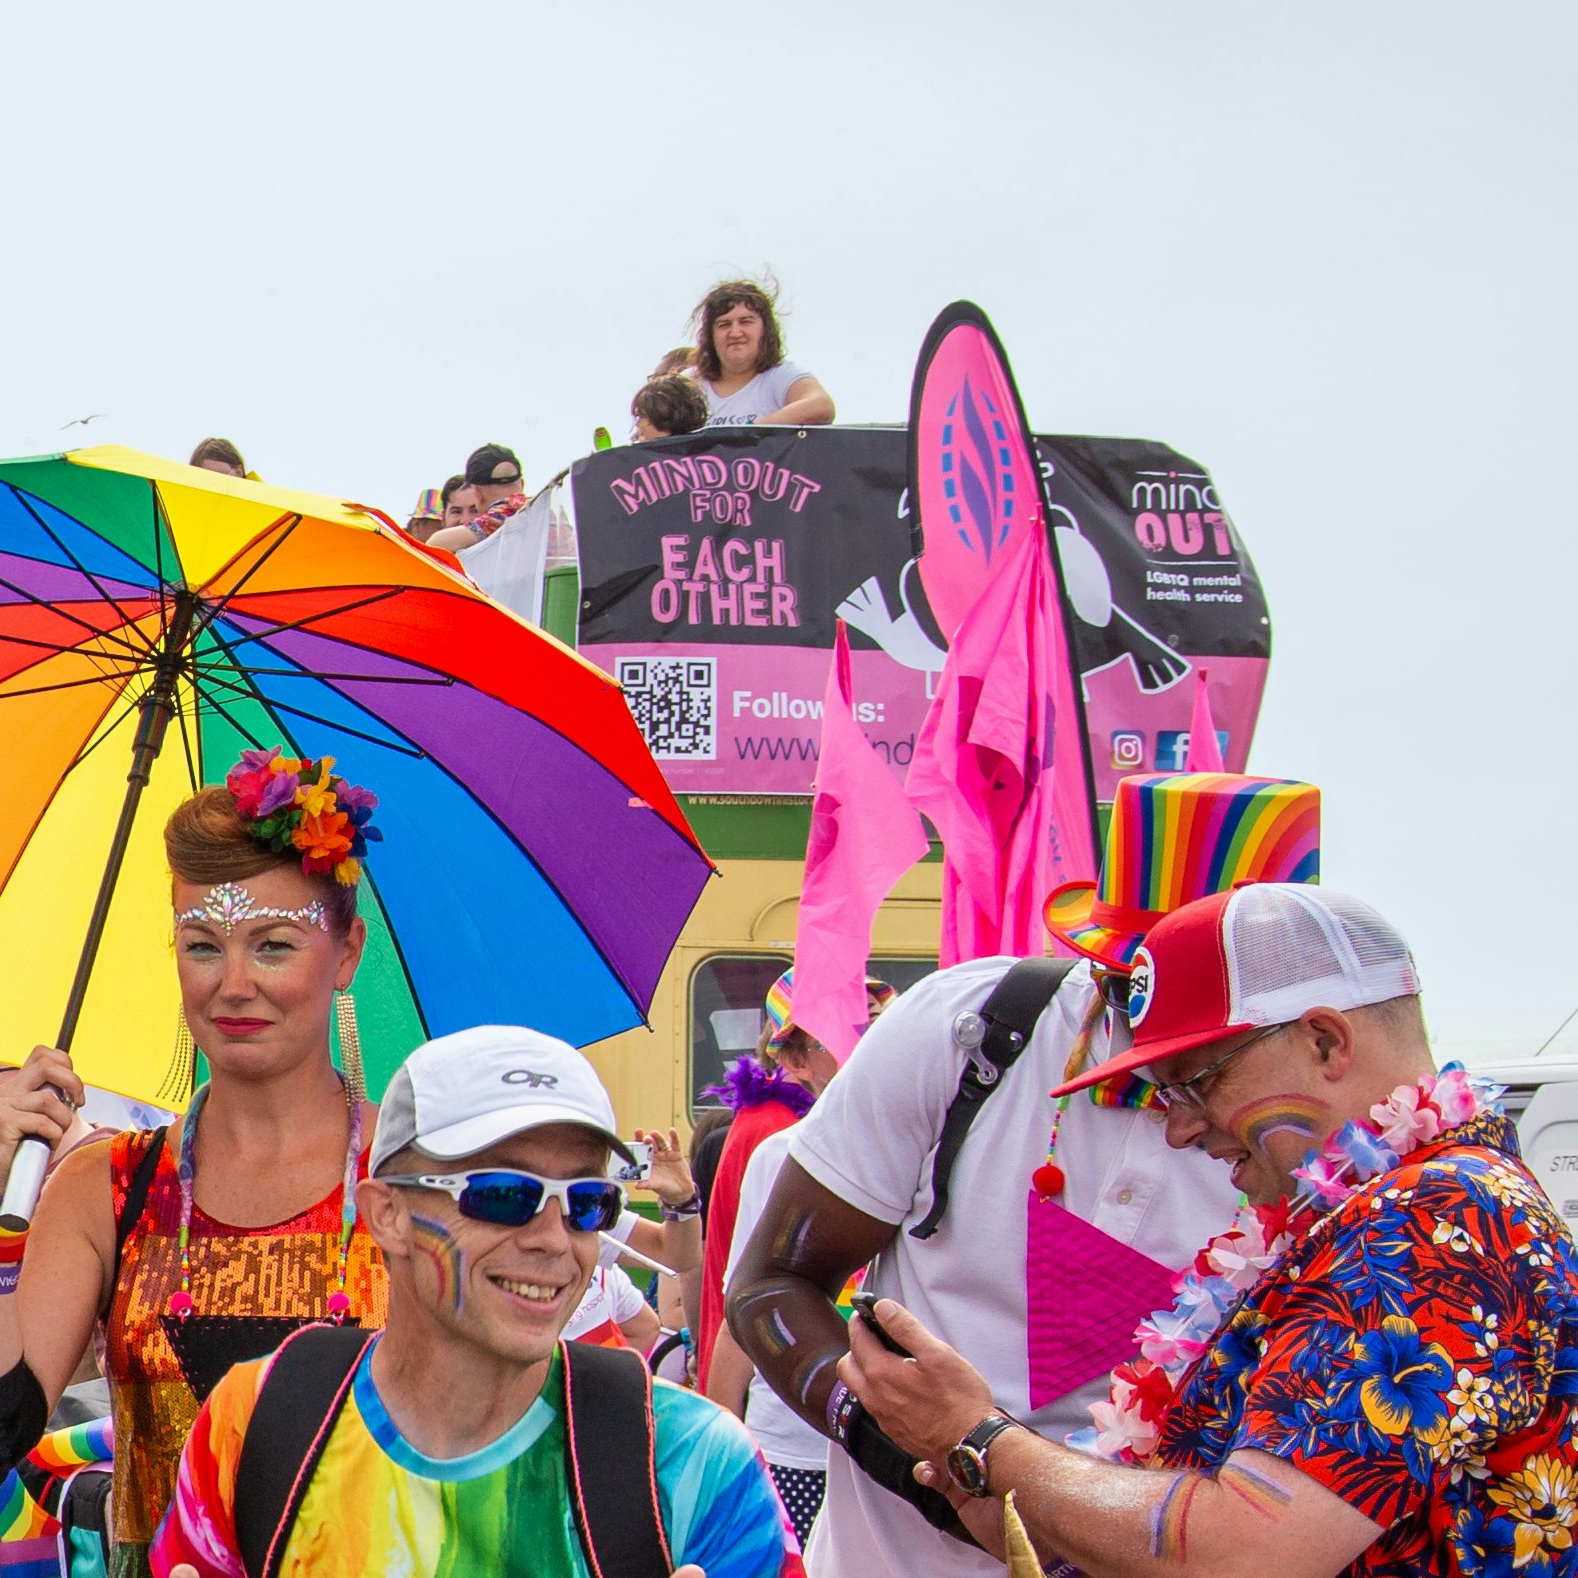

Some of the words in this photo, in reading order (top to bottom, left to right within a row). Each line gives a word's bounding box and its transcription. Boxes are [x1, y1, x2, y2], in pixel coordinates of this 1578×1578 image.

[610, 455, 728, 516] MIND
[731, 457, 822, 513] OUT
[689, 489, 752, 527] FOR
[1134, 511, 1232, 557] OUT
[660, 534, 786, 584] EACH
[1146, 570, 1190, 587] LGBTQ
[1192, 573, 1242, 586] mental
[650, 577, 801, 628] OTHER
[1146, 587, 1191, 602] health
[1194, 590, 1243, 603] service
